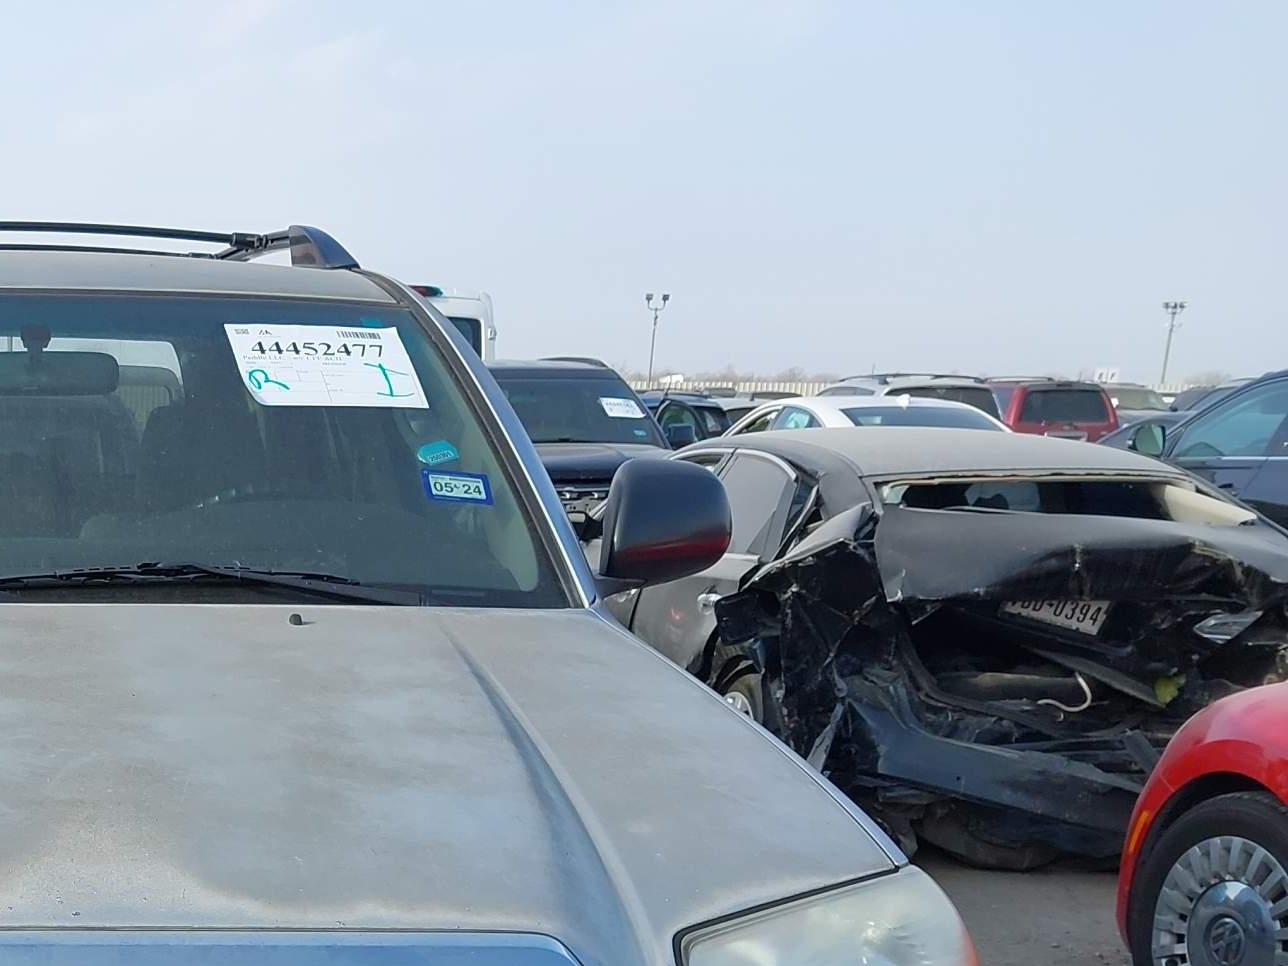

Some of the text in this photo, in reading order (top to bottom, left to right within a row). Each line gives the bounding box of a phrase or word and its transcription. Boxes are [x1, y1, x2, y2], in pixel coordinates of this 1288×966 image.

[251, 341, 383, 358] 44452477
[433, 481, 482, 496] 05 24
